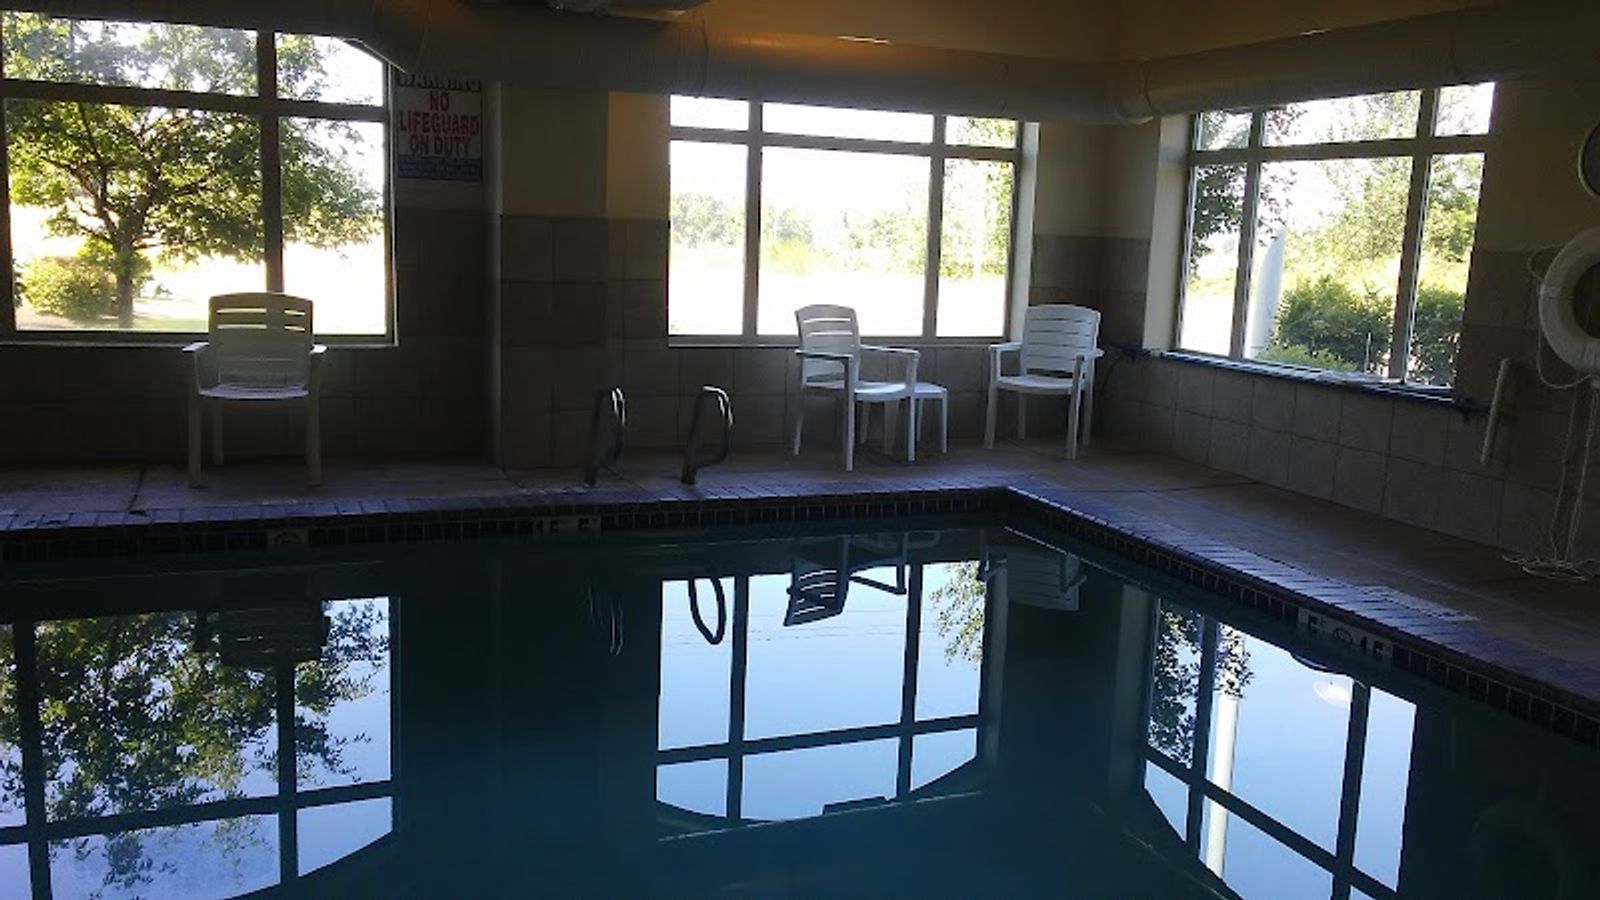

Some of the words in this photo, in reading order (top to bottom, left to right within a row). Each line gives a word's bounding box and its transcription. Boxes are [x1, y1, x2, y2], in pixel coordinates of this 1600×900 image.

[429, 91, 449, 111] NO
[399, 111, 480, 136] LIFEGUARD
[409, 134, 429, 155] ON
[434, 135, 472, 156] DUTY
